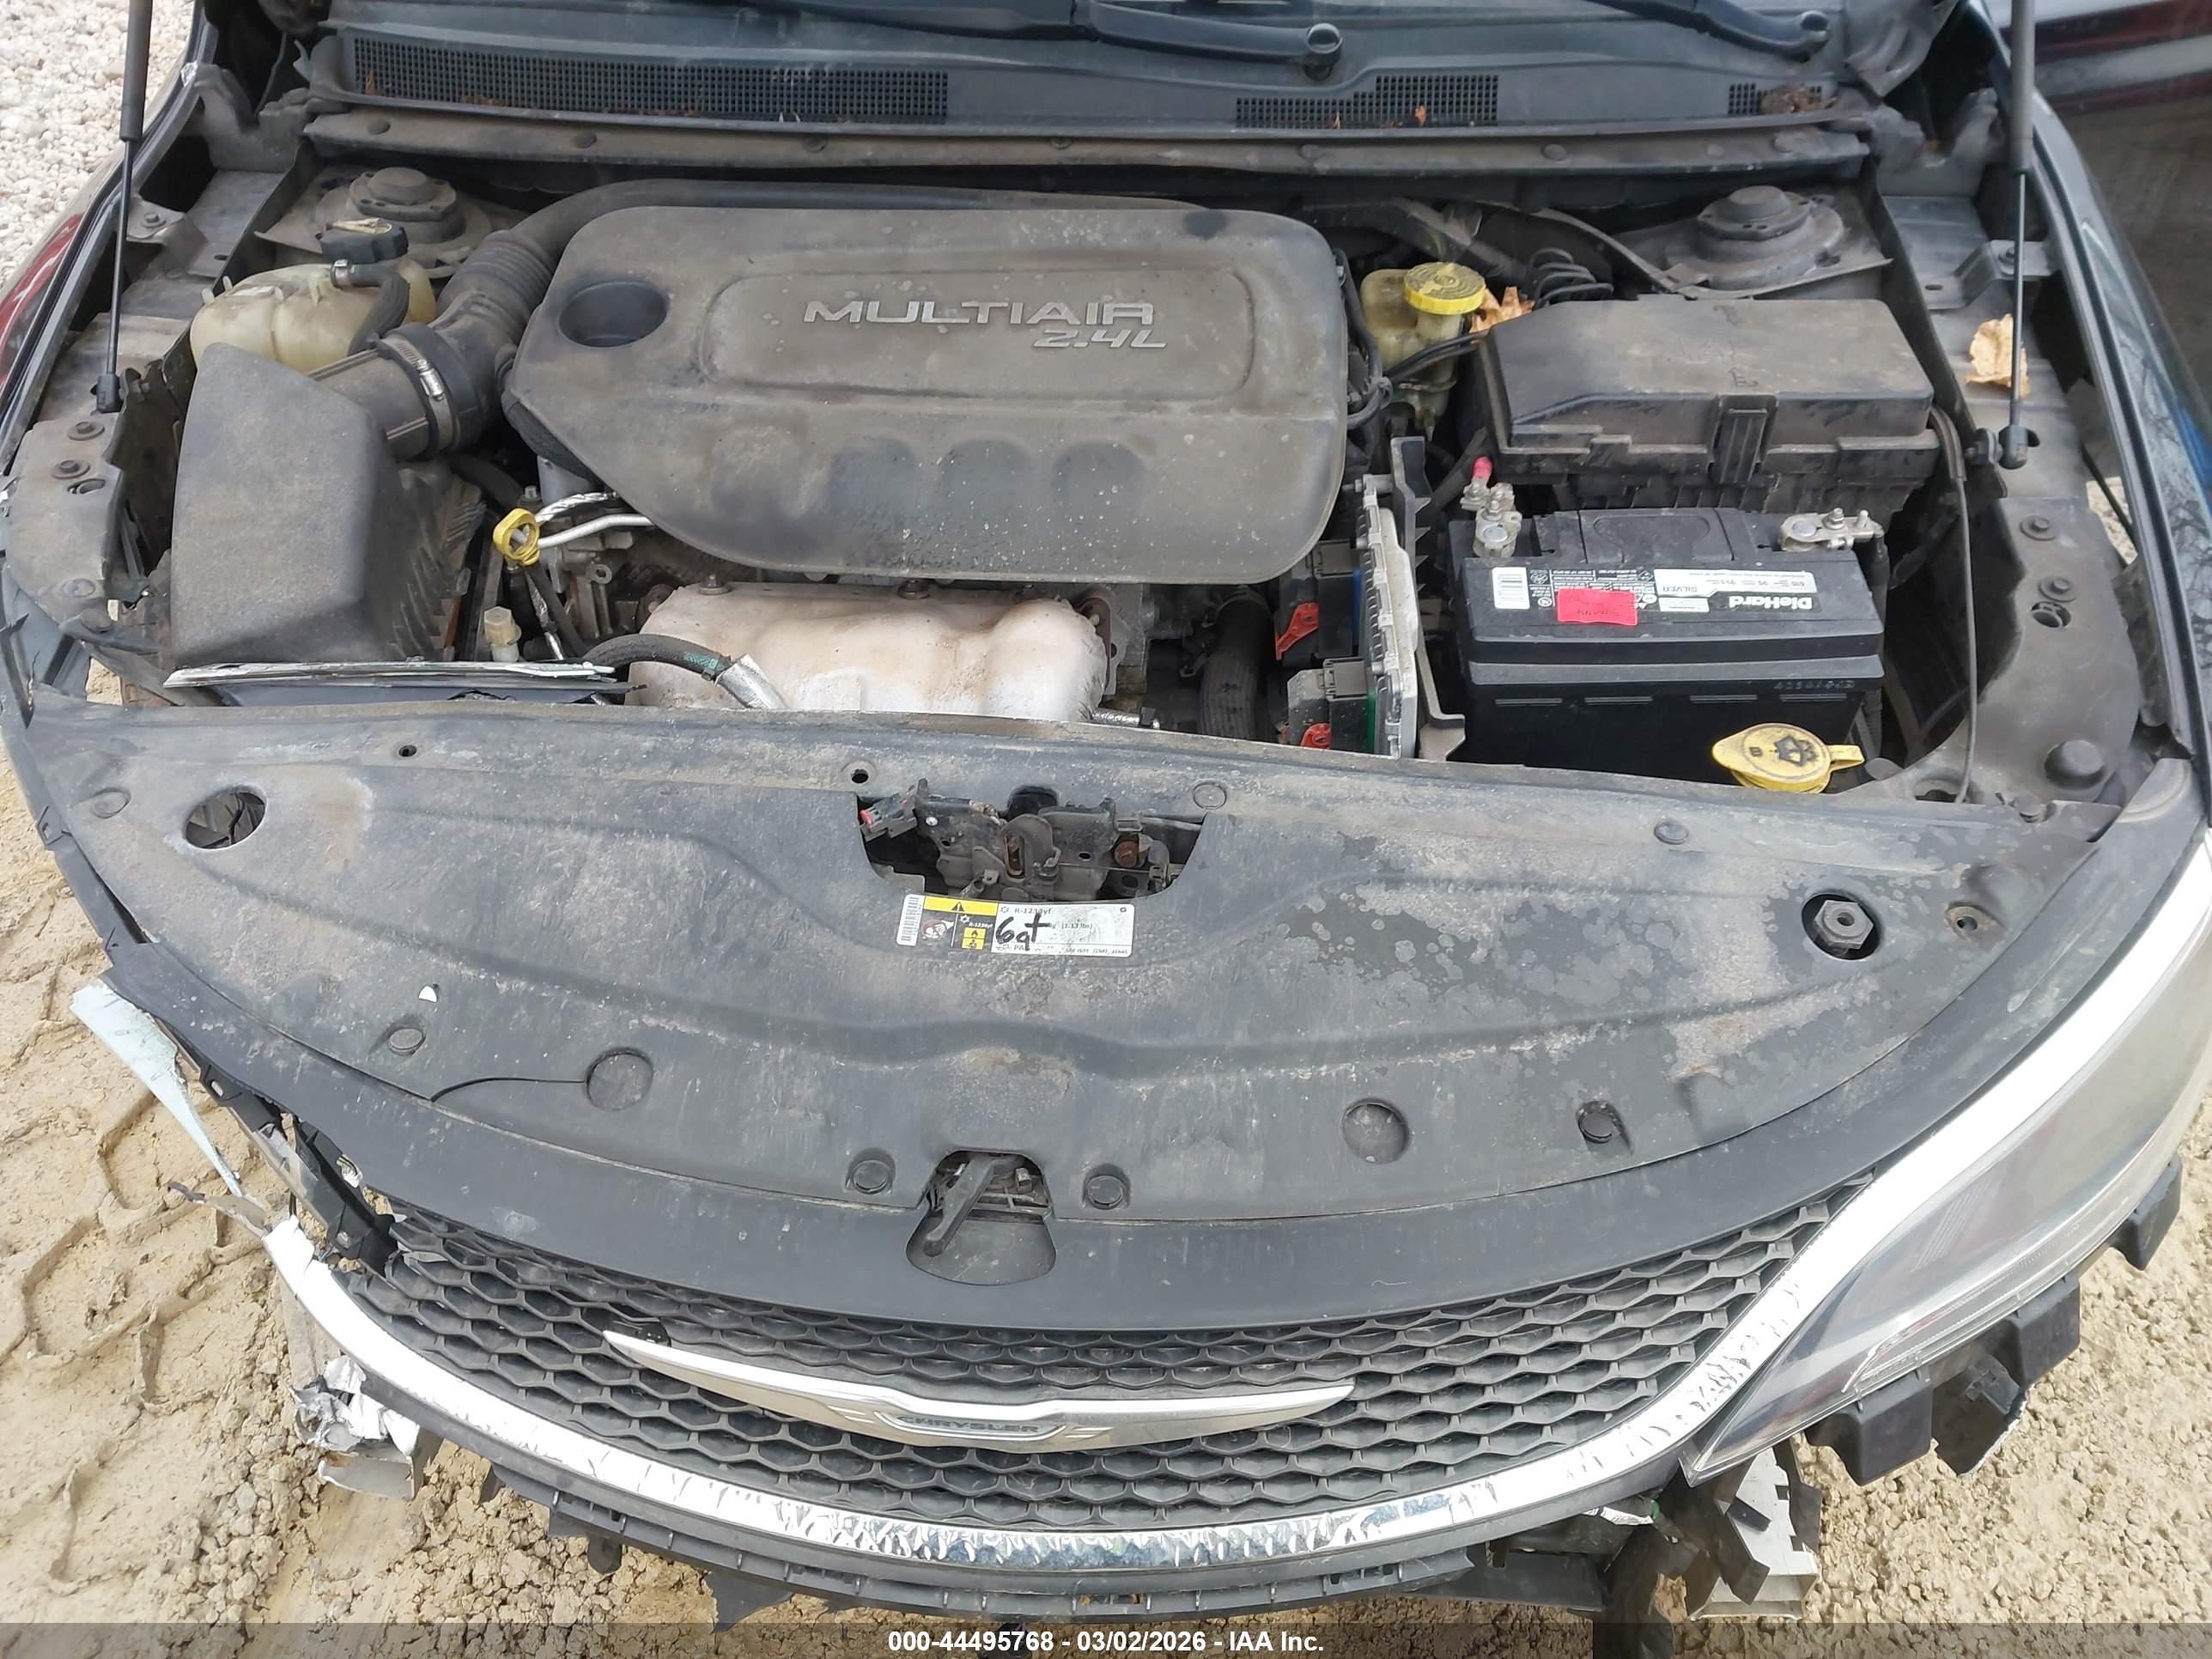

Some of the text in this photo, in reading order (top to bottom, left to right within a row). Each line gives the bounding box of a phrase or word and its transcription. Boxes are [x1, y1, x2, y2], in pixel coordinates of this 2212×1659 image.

[803, 301, 1154, 325] MULTIAIR
[1033, 329, 1168, 348] 2.4L
[1729, 595, 1813, 611] DieHard
[896, 1417, 1038, 1433] CHRYSLER
